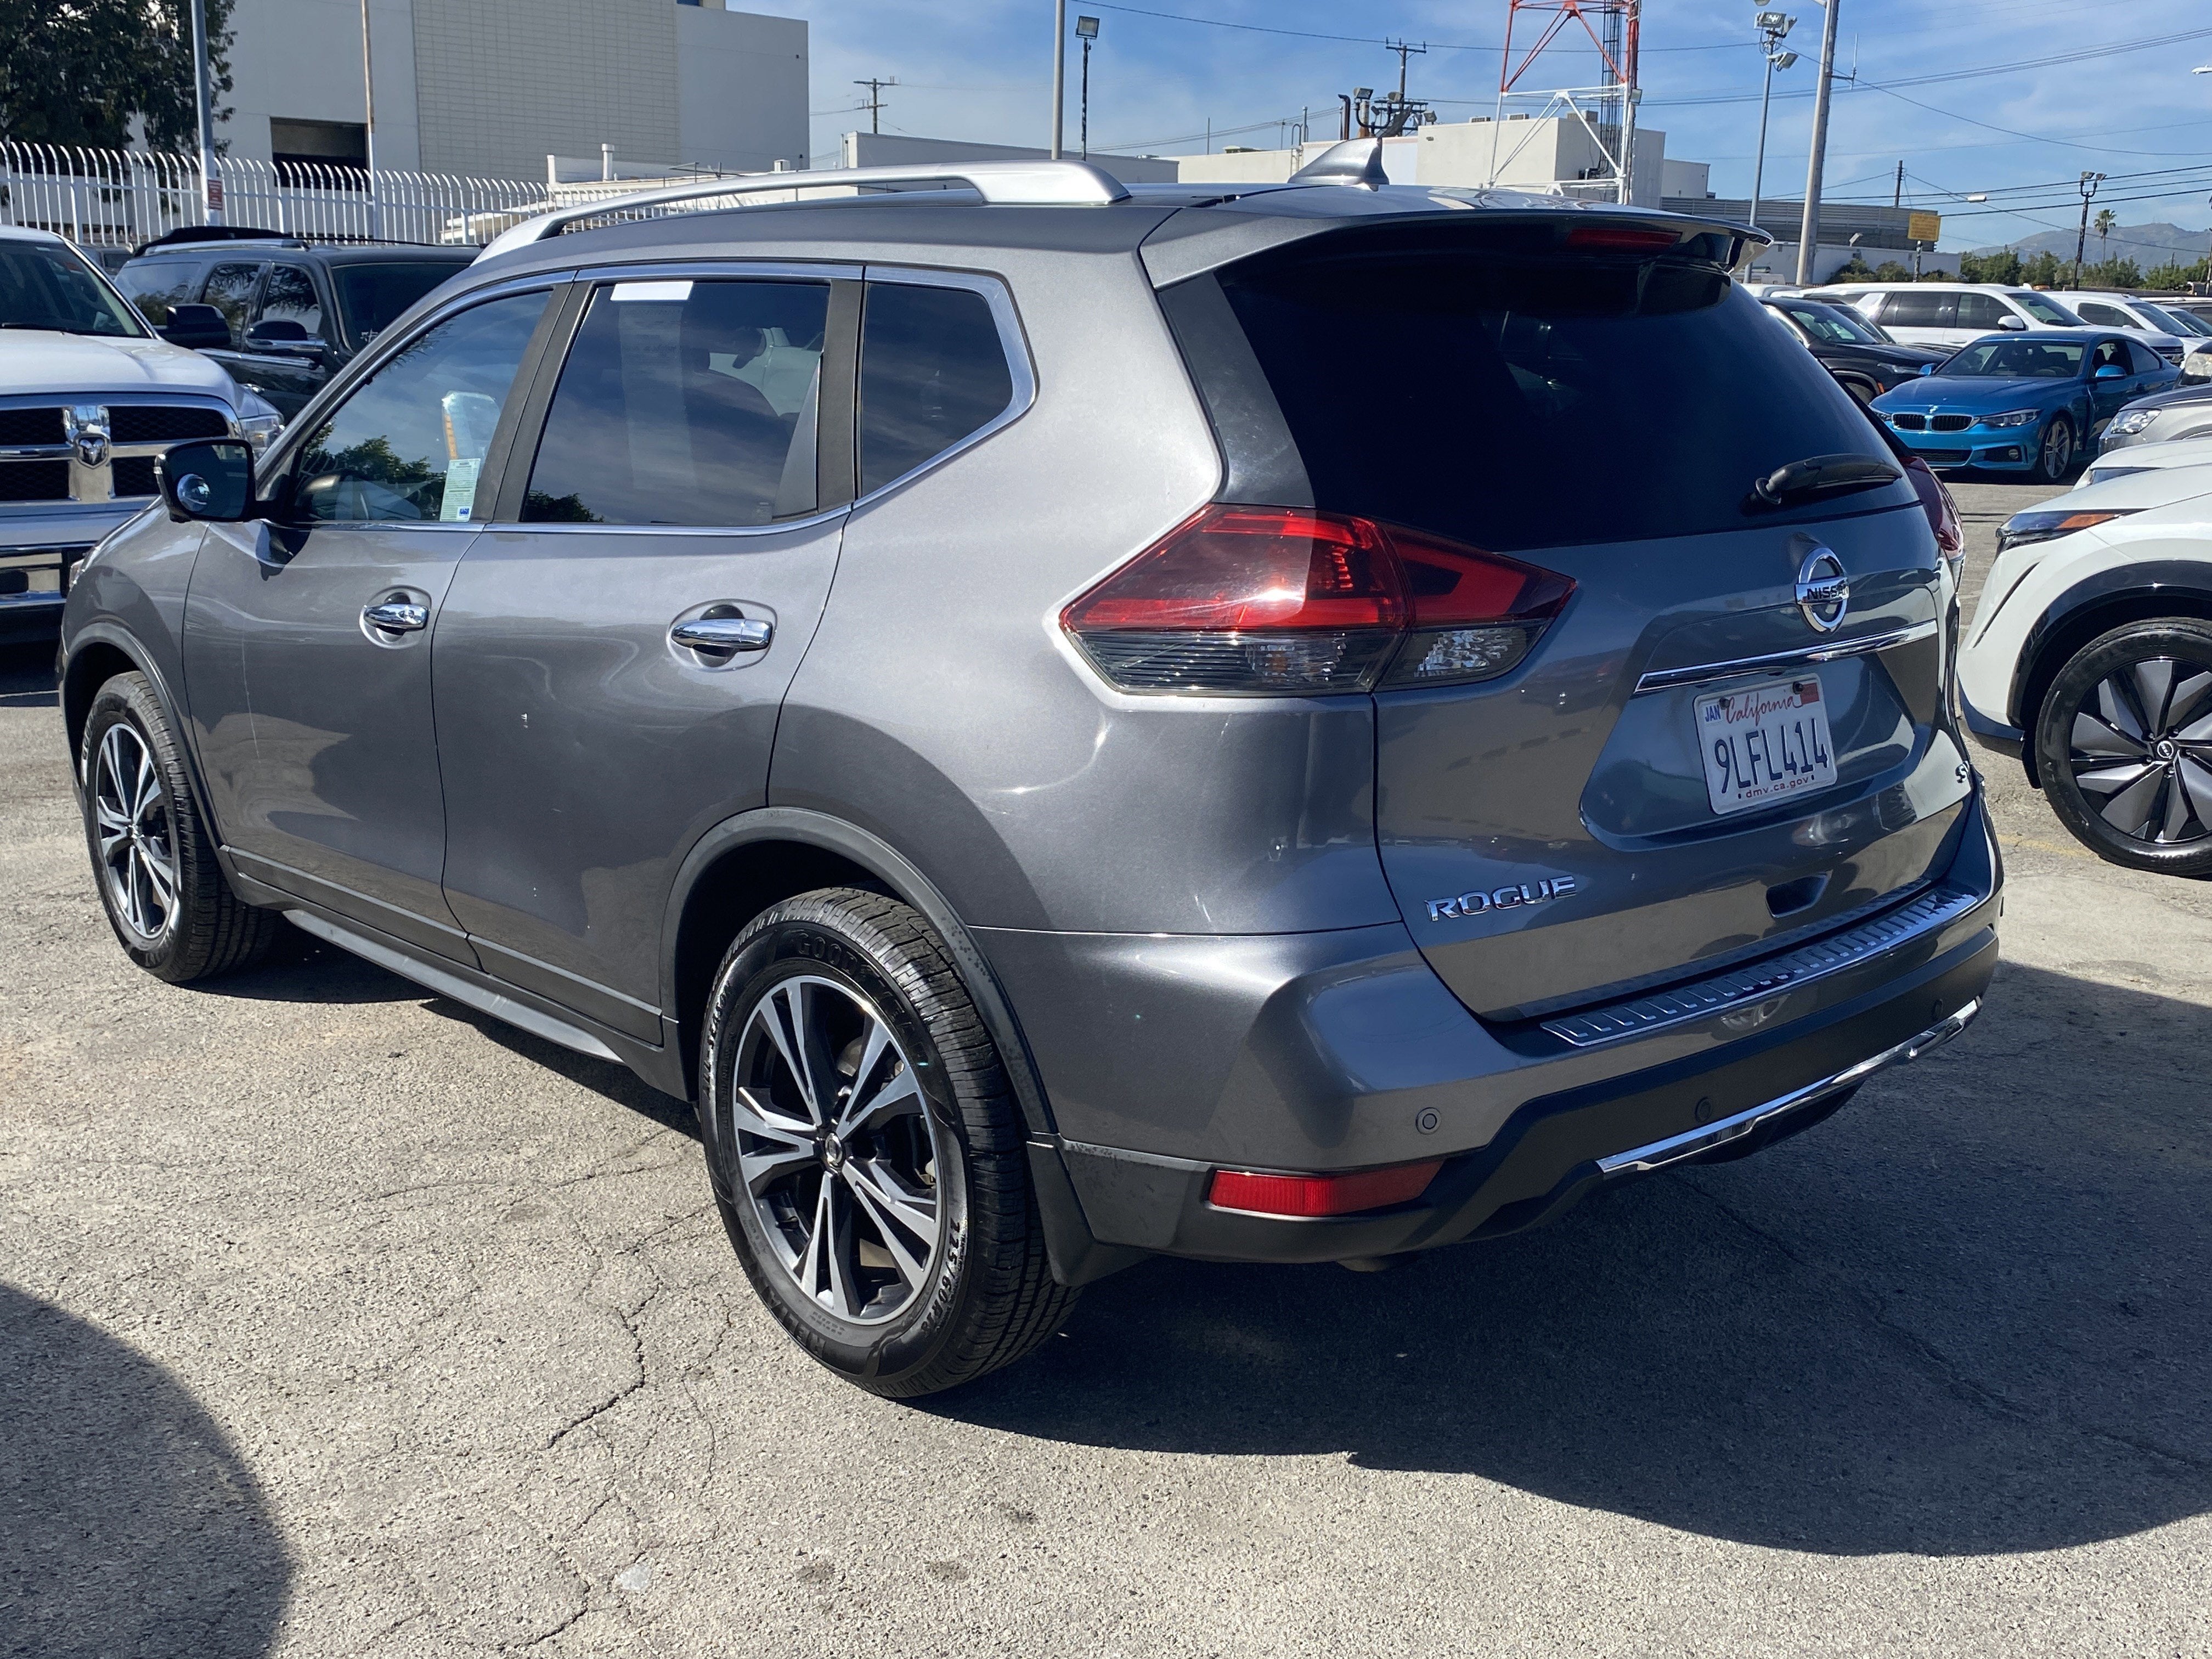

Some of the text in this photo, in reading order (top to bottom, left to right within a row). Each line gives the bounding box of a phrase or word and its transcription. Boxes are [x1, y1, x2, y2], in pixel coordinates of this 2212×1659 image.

[1807, 582, 1849, 600] NISSAN
[1705, 704, 1722, 723] JAN
[1725, 692, 1803, 726] California
[1714, 718, 1829, 794] 9LFL414
[1746, 776, 1809, 798] dmv.ca.gov
[1424, 875, 1578, 922] ROGUE
[921, 1216, 961, 1339] 225/60R18
